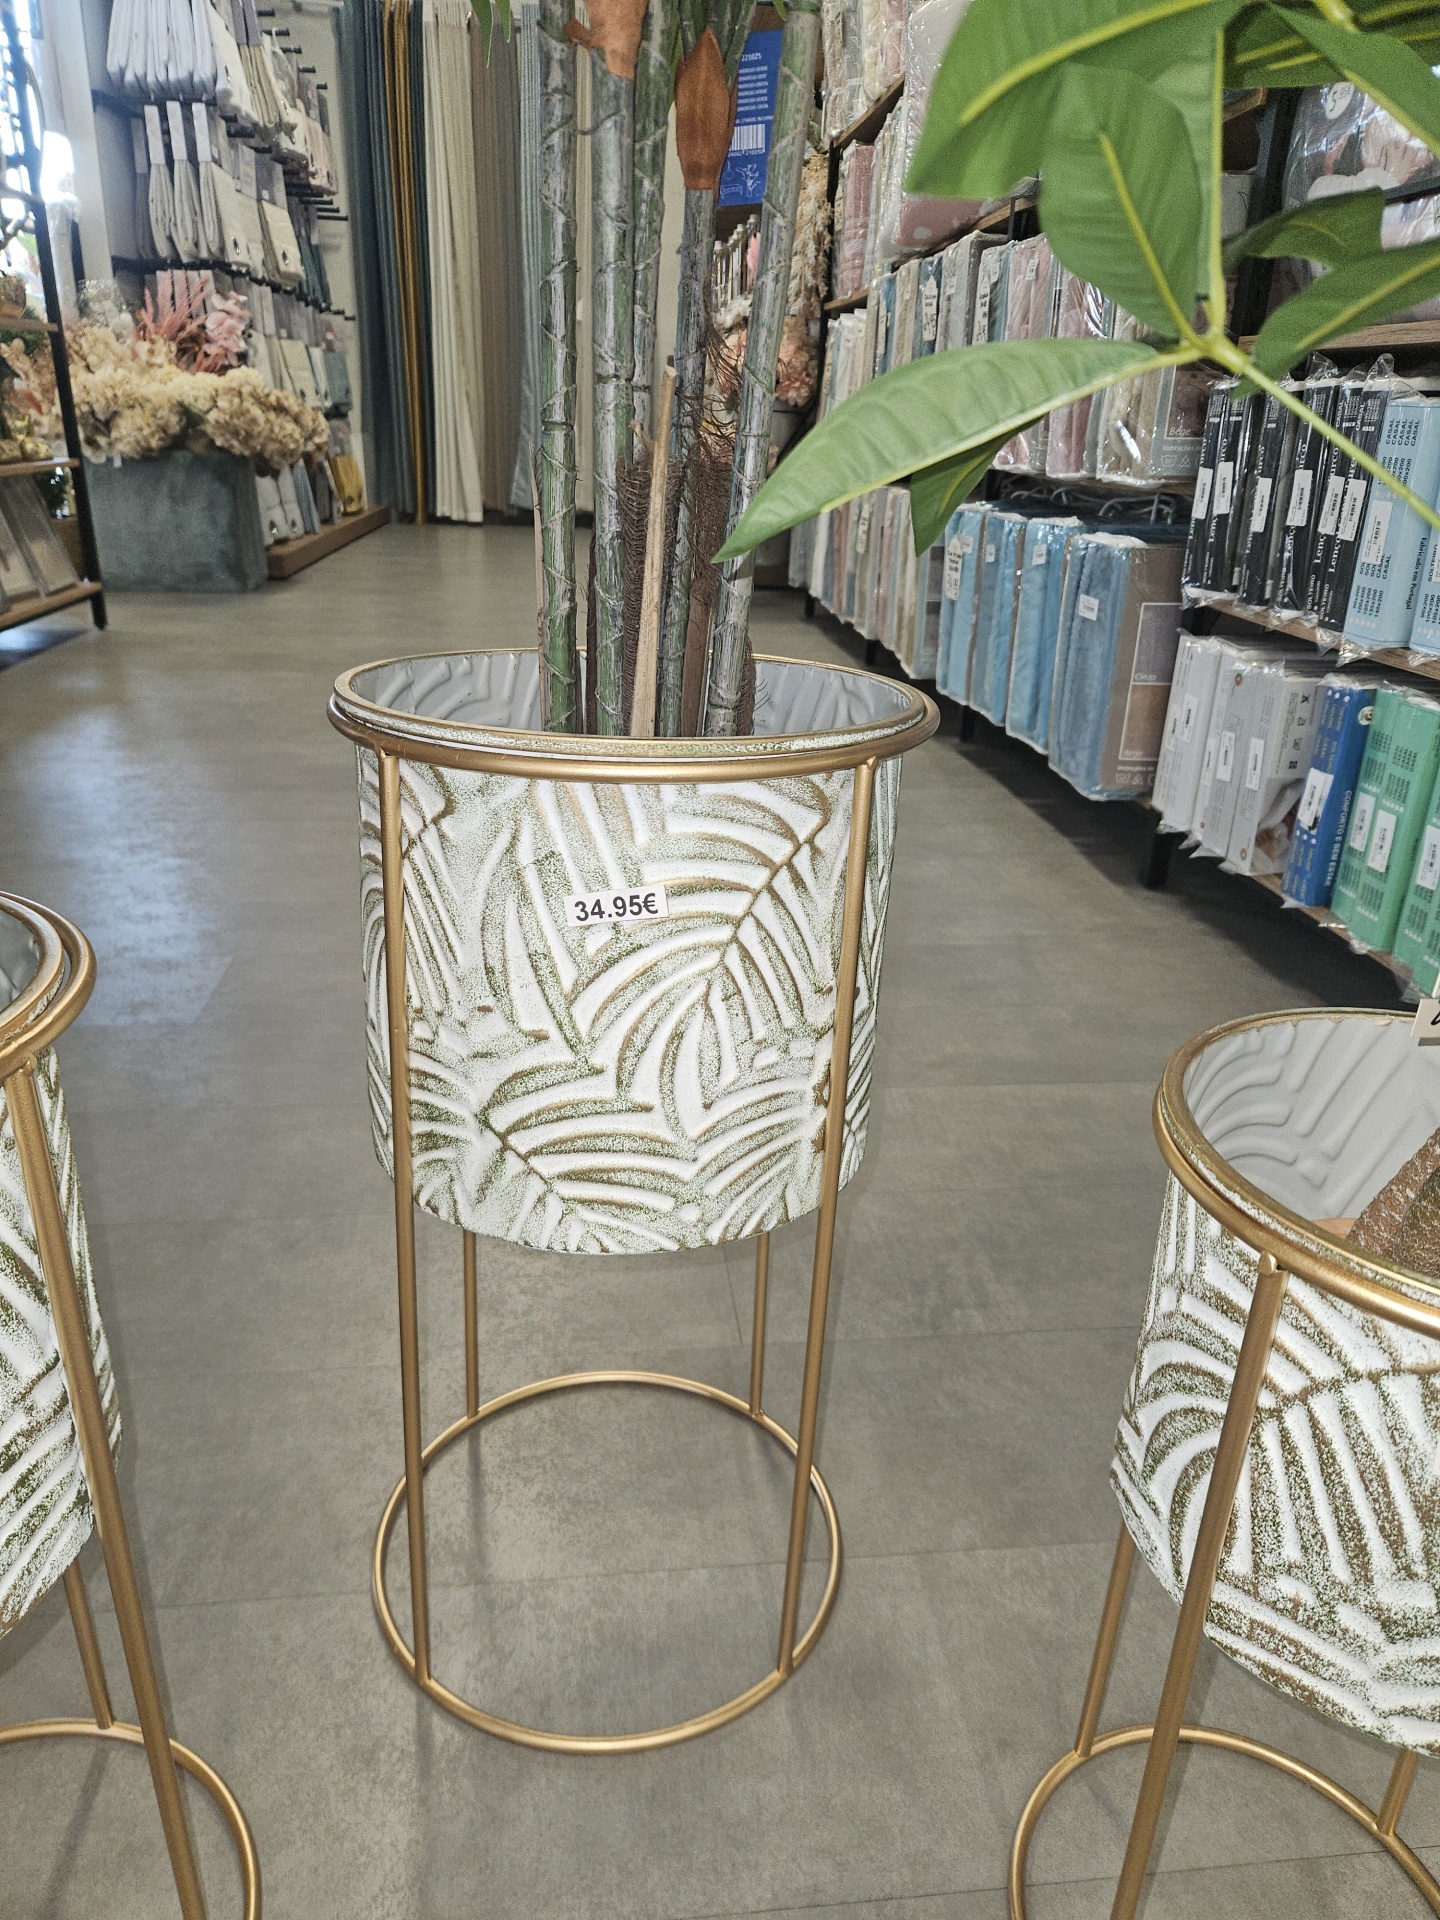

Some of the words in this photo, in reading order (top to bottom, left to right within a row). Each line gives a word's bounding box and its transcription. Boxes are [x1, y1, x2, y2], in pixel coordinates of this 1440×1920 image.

[1336, 400, 1344, 428] CASAL
[1356, 402, 1366, 431] CASAL
[1386, 419, 1394, 445] CASAL
[1392, 420, 1401, 445] CASAL
[1398, 419, 1407, 446] CASAL
[1404, 420, 1414, 446] CASAL
[1403, 458, 1411, 486] 00x200
[1410, 420, 1420, 447] CASAL
[1413, 537, 1427, 569] Fabricado
[1306, 574, 1316, 610] SOLTEIRO
[1313, 534, 1327, 564] Lenç
[1374, 590, 1384, 617] 140x200
[1382, 554, 1391, 580] CASAL
[1410, 569, 1418, 582] em
[1320, 583, 1330, 620] SOLTEIRO
[1406, 583, 1417, 610] Portugal
[1337, 789, 1353, 835] CONFORTO
[574, 892, 659, 922] 34.95€
